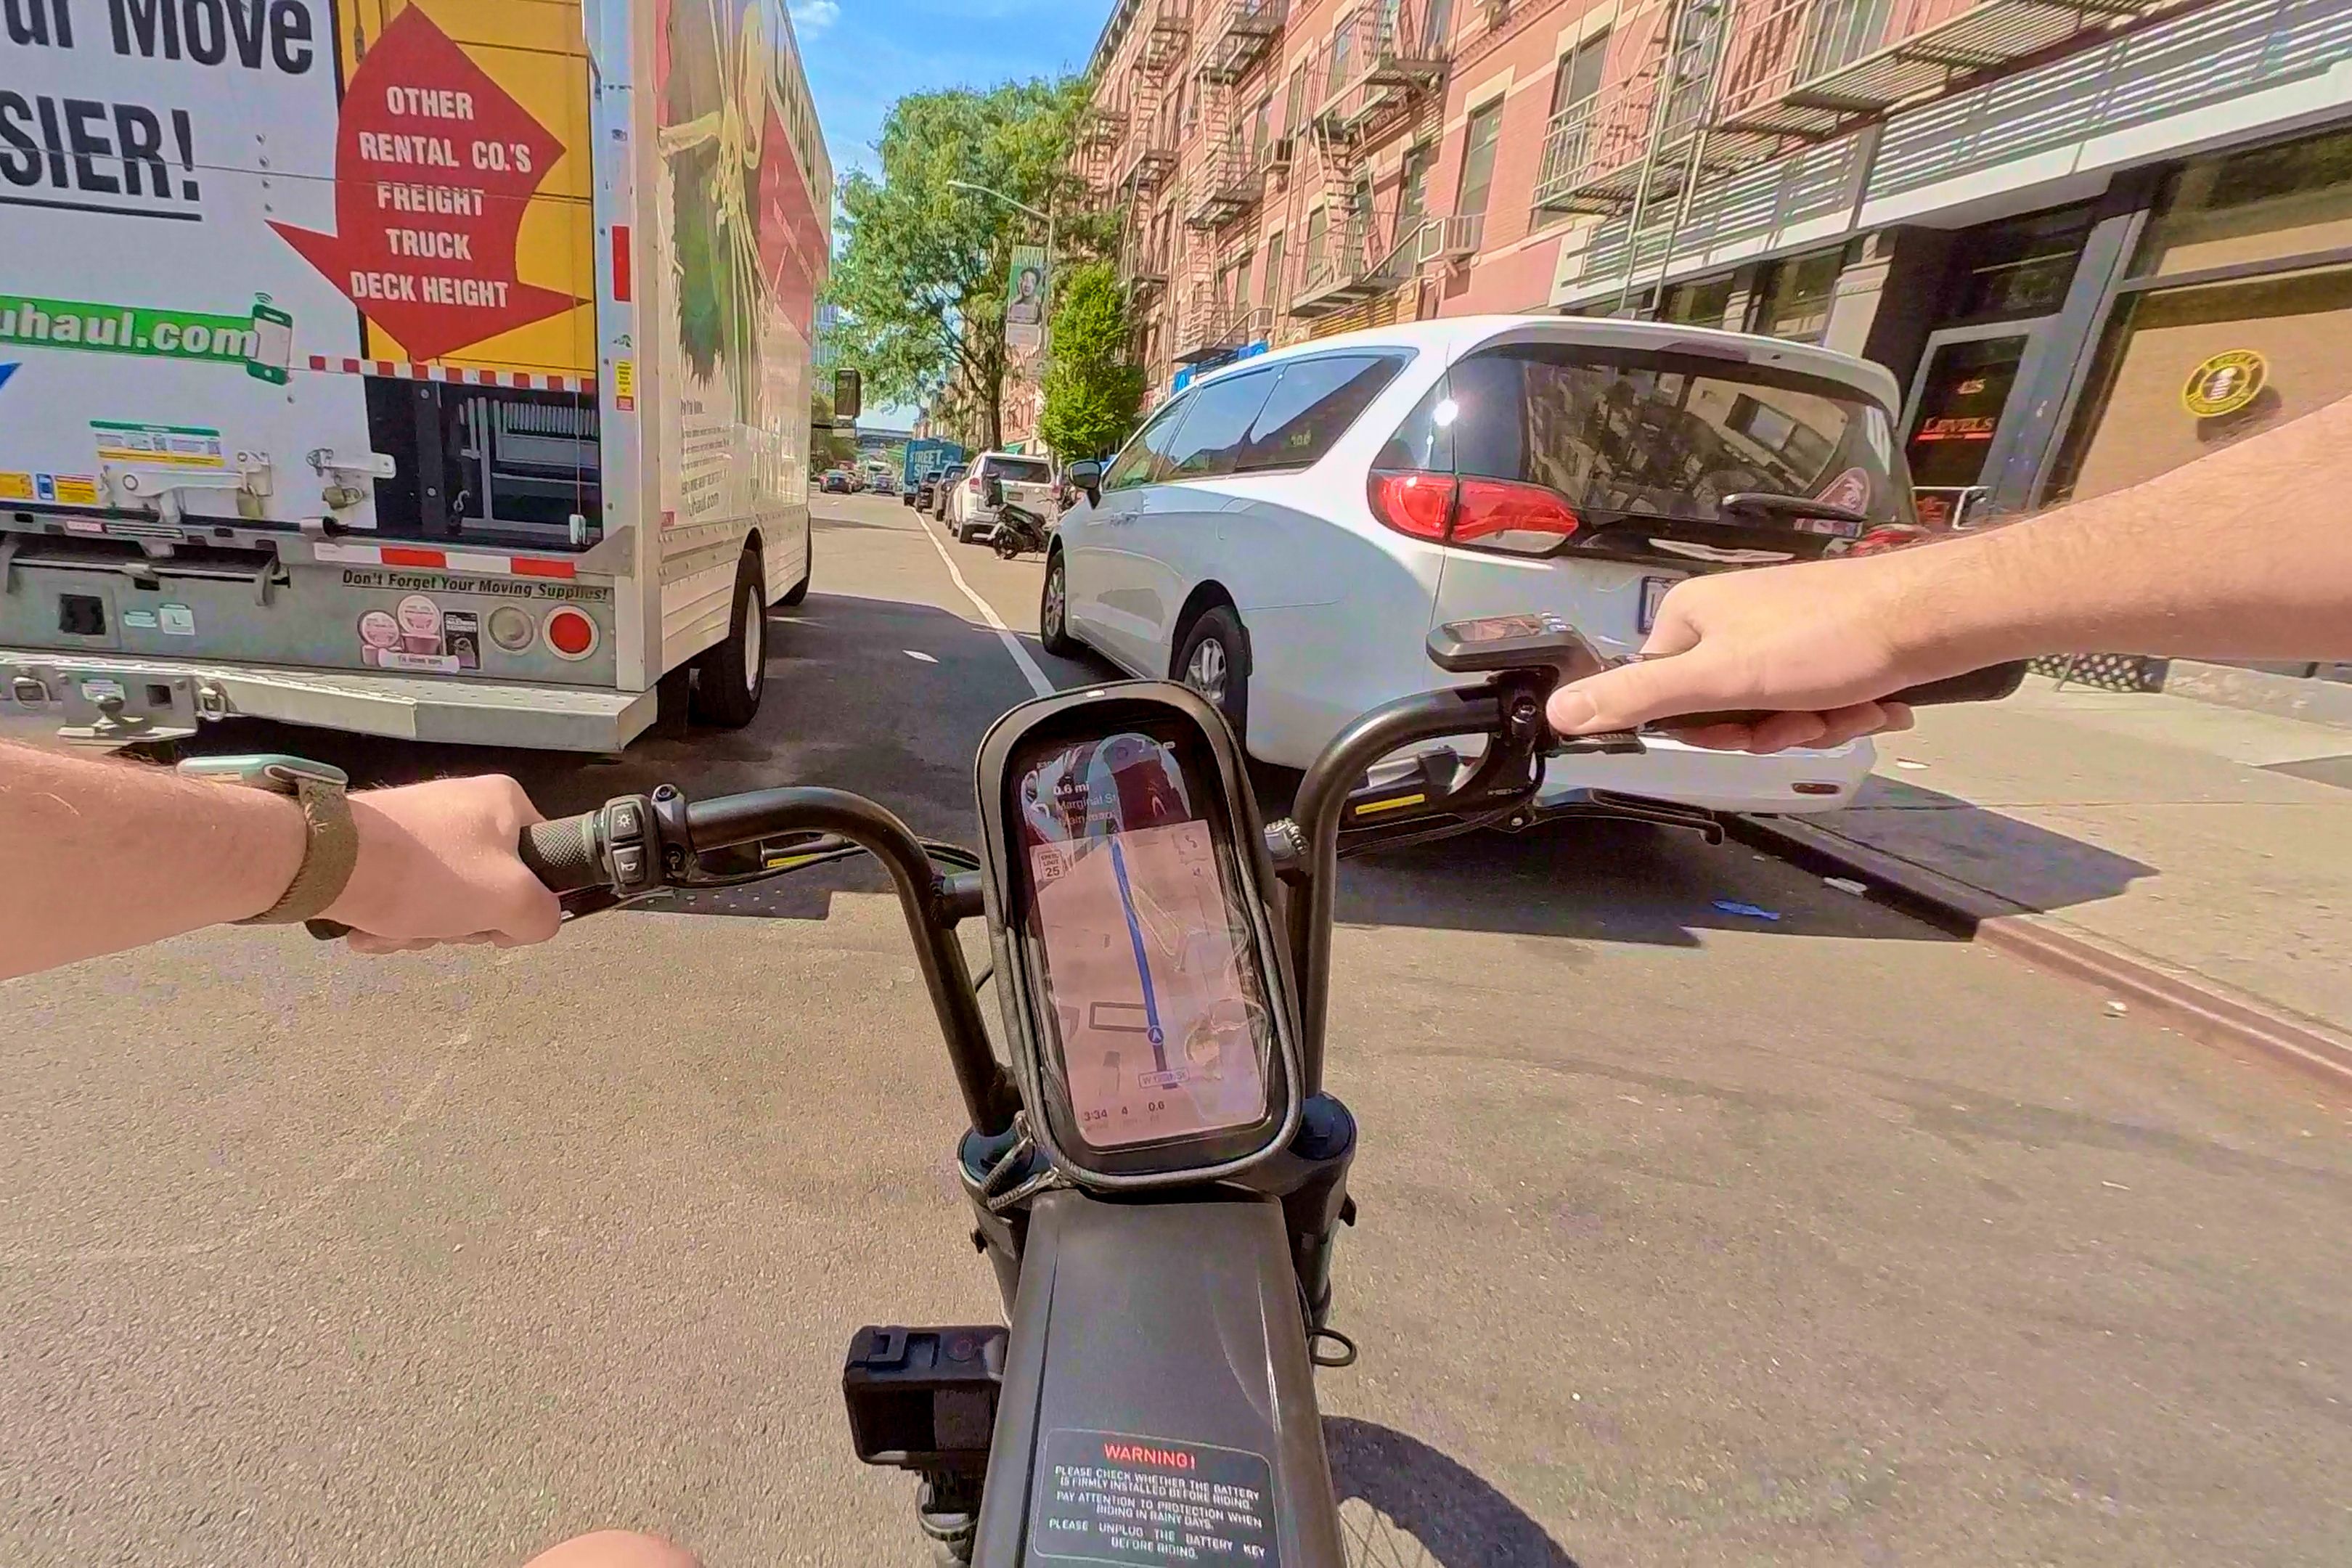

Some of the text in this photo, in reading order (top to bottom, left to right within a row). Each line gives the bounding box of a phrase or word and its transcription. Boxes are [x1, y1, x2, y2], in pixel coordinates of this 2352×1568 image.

[107, 0, 314, 74] Move
[386, 86, 474, 121] OTHER
[0, 90, 201, 201] SIER!
[359, 131, 533, 173] RENTAL CO.'S
[376, 181, 485, 216] FREIGHT
[385, 228, 474, 261] TRUCK
[350, 271, 509, 309] DECK HEIGHT
[909, 449, 944, 465] STREET
[342, 569, 608, 600] Don't Forget Your Moving Supplies!
[1053, 783, 1073, 796] 0.6
[1045, 866, 1060, 877] 25
[1083, 1109, 1108, 1122] 3:34
[1121, 1106, 1129, 1115] 4
[1104, 1442, 1196, 1470] WARNING!
[1055, 1465, 1260, 1501] PLEASE CHECK WHETHER THE BATTERY
[1061, 1477, 1254, 1512] IS FIRMLY INSTALLED BEFORE RIDING.
[1056, 1490, 1262, 1529] PAY ATTENTION TO PROTECTION WHEN
[1096, 1504, 1214, 1531] RIDING IN RAINY DAYS.
[1049, 1518, 1265, 1558] PLEASE UNPLUG THE BATTERY KEY
[1111, 1536, 1198, 1559] BEFORE RIDING.
